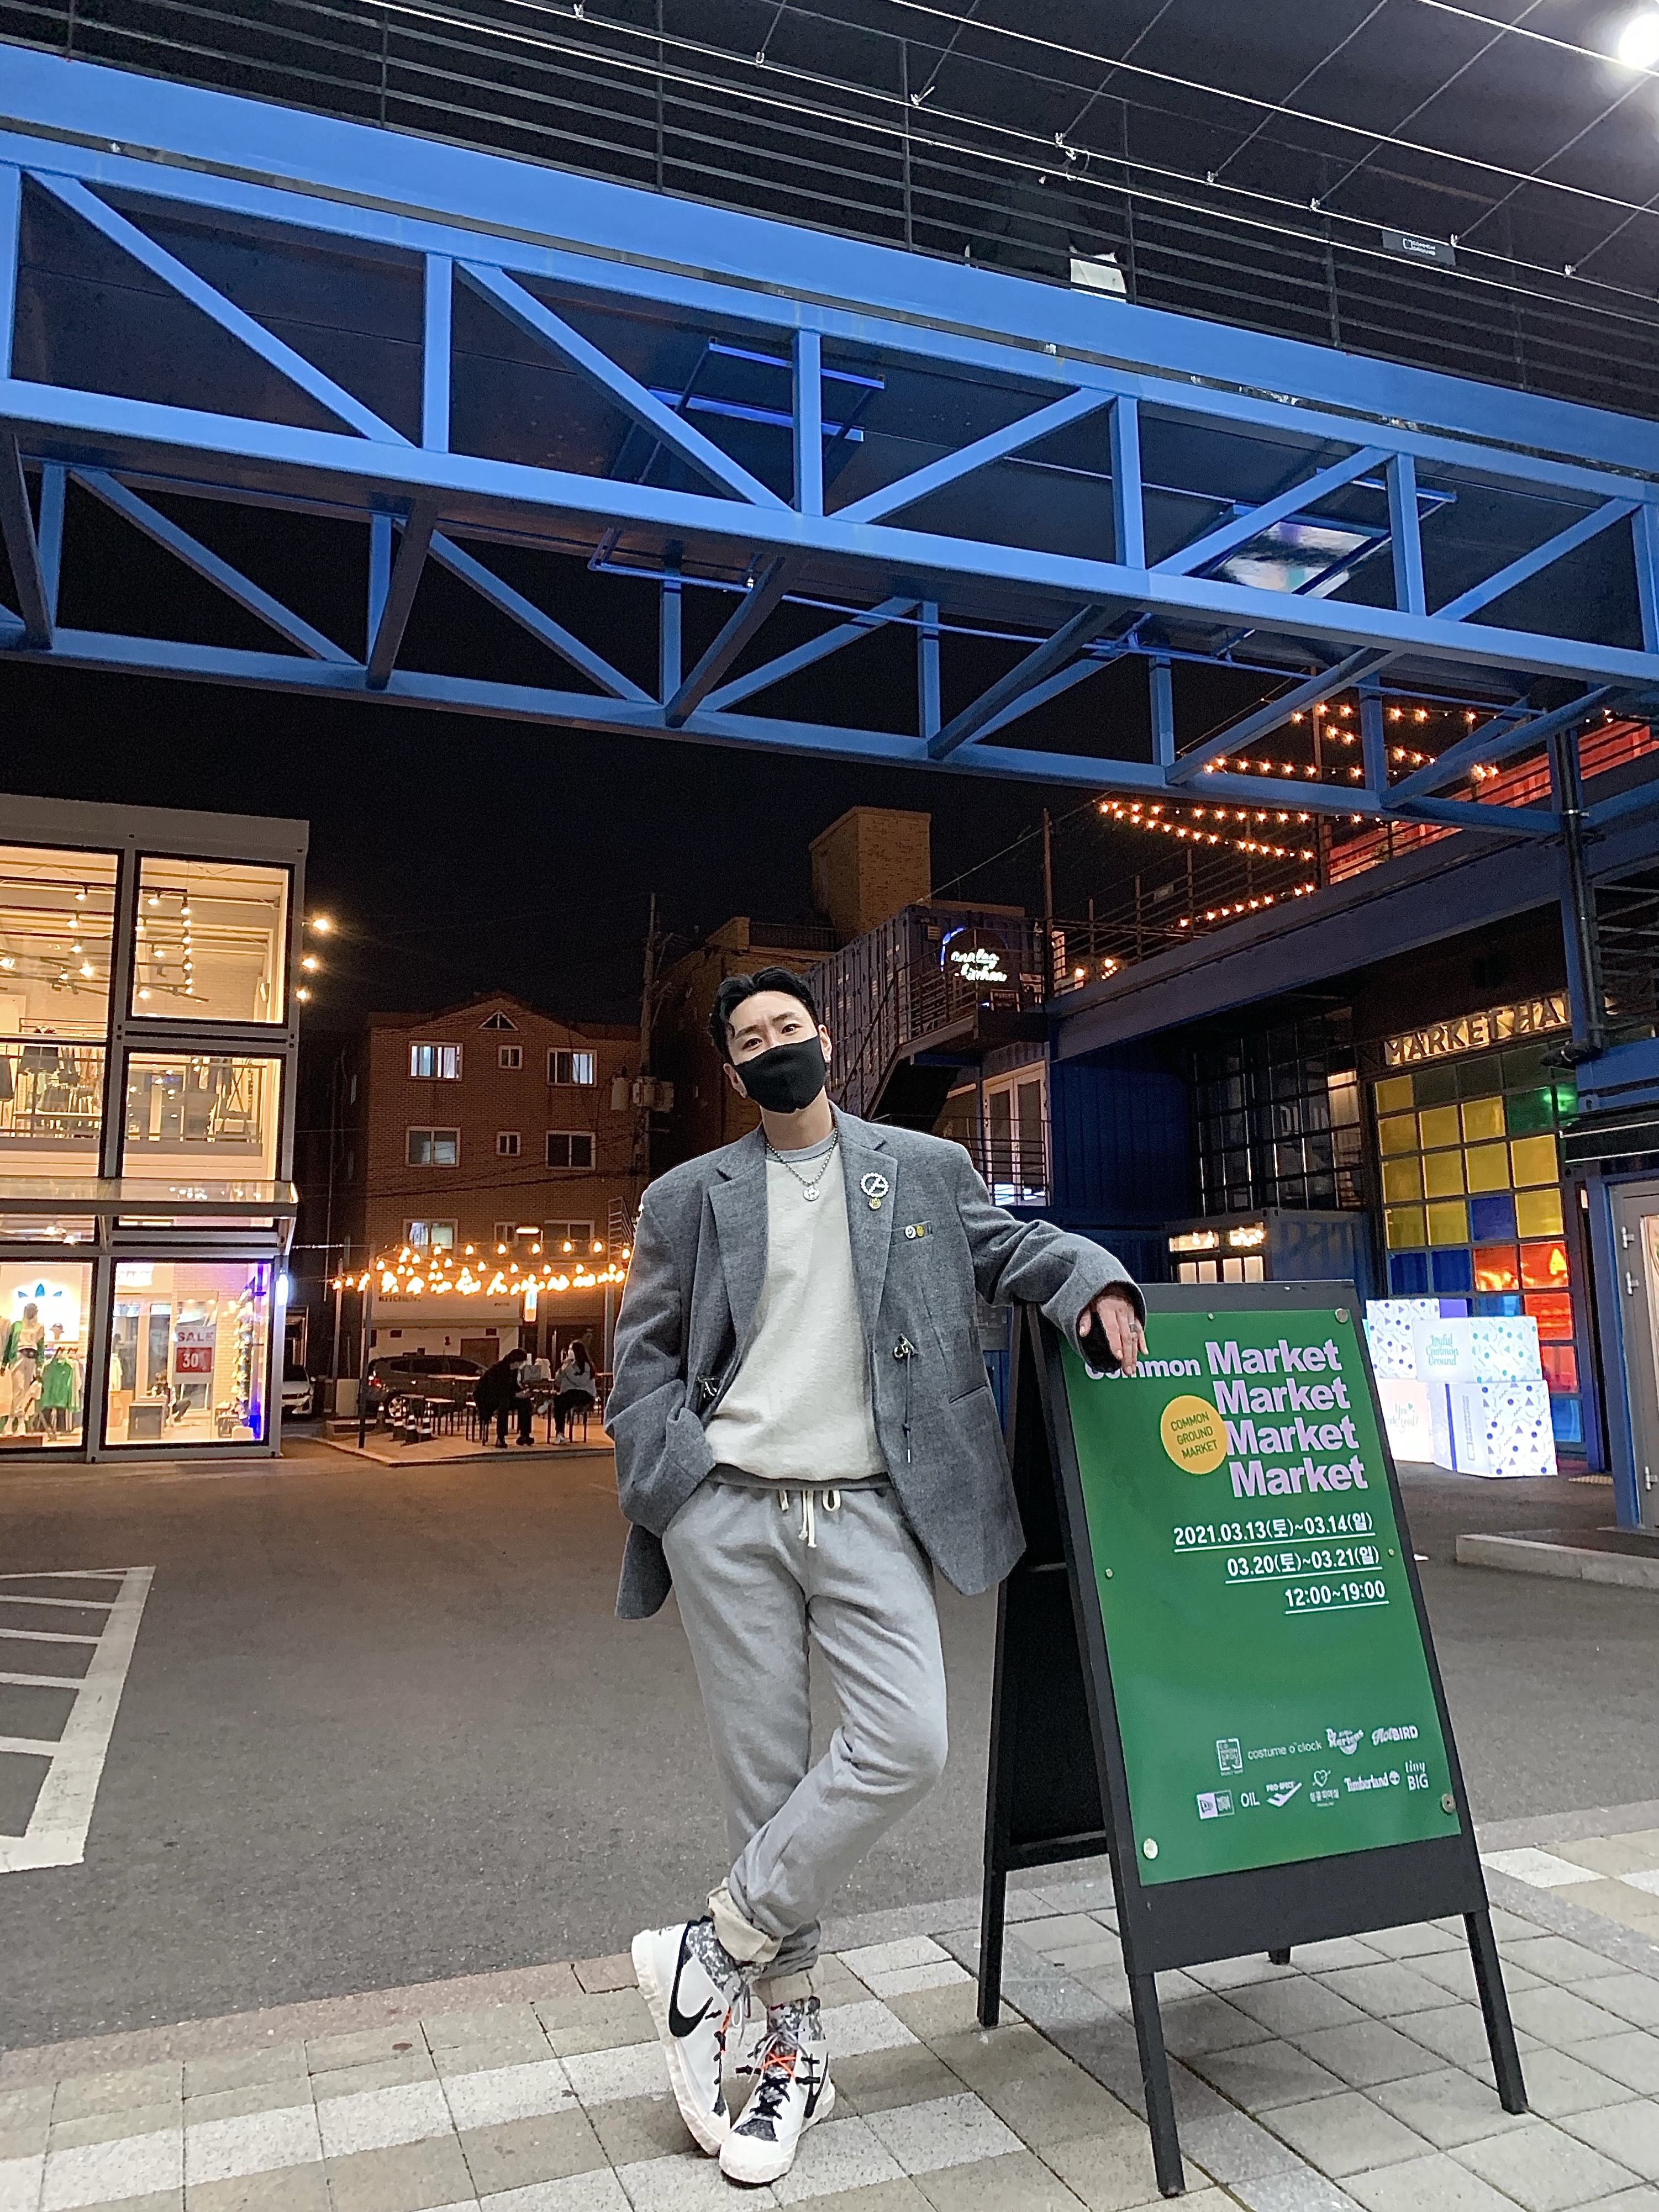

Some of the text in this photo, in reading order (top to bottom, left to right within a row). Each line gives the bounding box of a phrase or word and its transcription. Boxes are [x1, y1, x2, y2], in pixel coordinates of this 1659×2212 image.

[1384, 1010, 1504, 1064] MARKET
[178, 1332, 214, 1342] SALE
[1205, 1339, 1342, 1376] Market
[1426, 1344, 1459, 1356] Common
[1428, 1355, 1457, 1366] Ground
[1212, 1376, 1351, 1415] Market
[1171, 1411, 1210, 1432] COMMON
[1177, 1426, 1213, 1445] GROUND
[1223, 1415, 1360, 1456] Market
[1181, 1439, 1218, 1459] MARKET
[1229, 1455, 1369, 1498] Market
[1173, 1512, 1373, 1546] 2021.03.13(토)~03.14(일)
[1227, 1546, 1380, 1577] 03.20(토)~03.21(일)
[1284, 1580, 1386, 1607] 12:00~19:00
[1247, 1746, 1287, 1760] costume
[1405, 1760, 1425, 1773] tiny
[1344, 1771, 1389, 1792] Timberland
[1407, 1773, 1429, 1791] BIG
[1240, 1792, 1261, 1807] OIL
